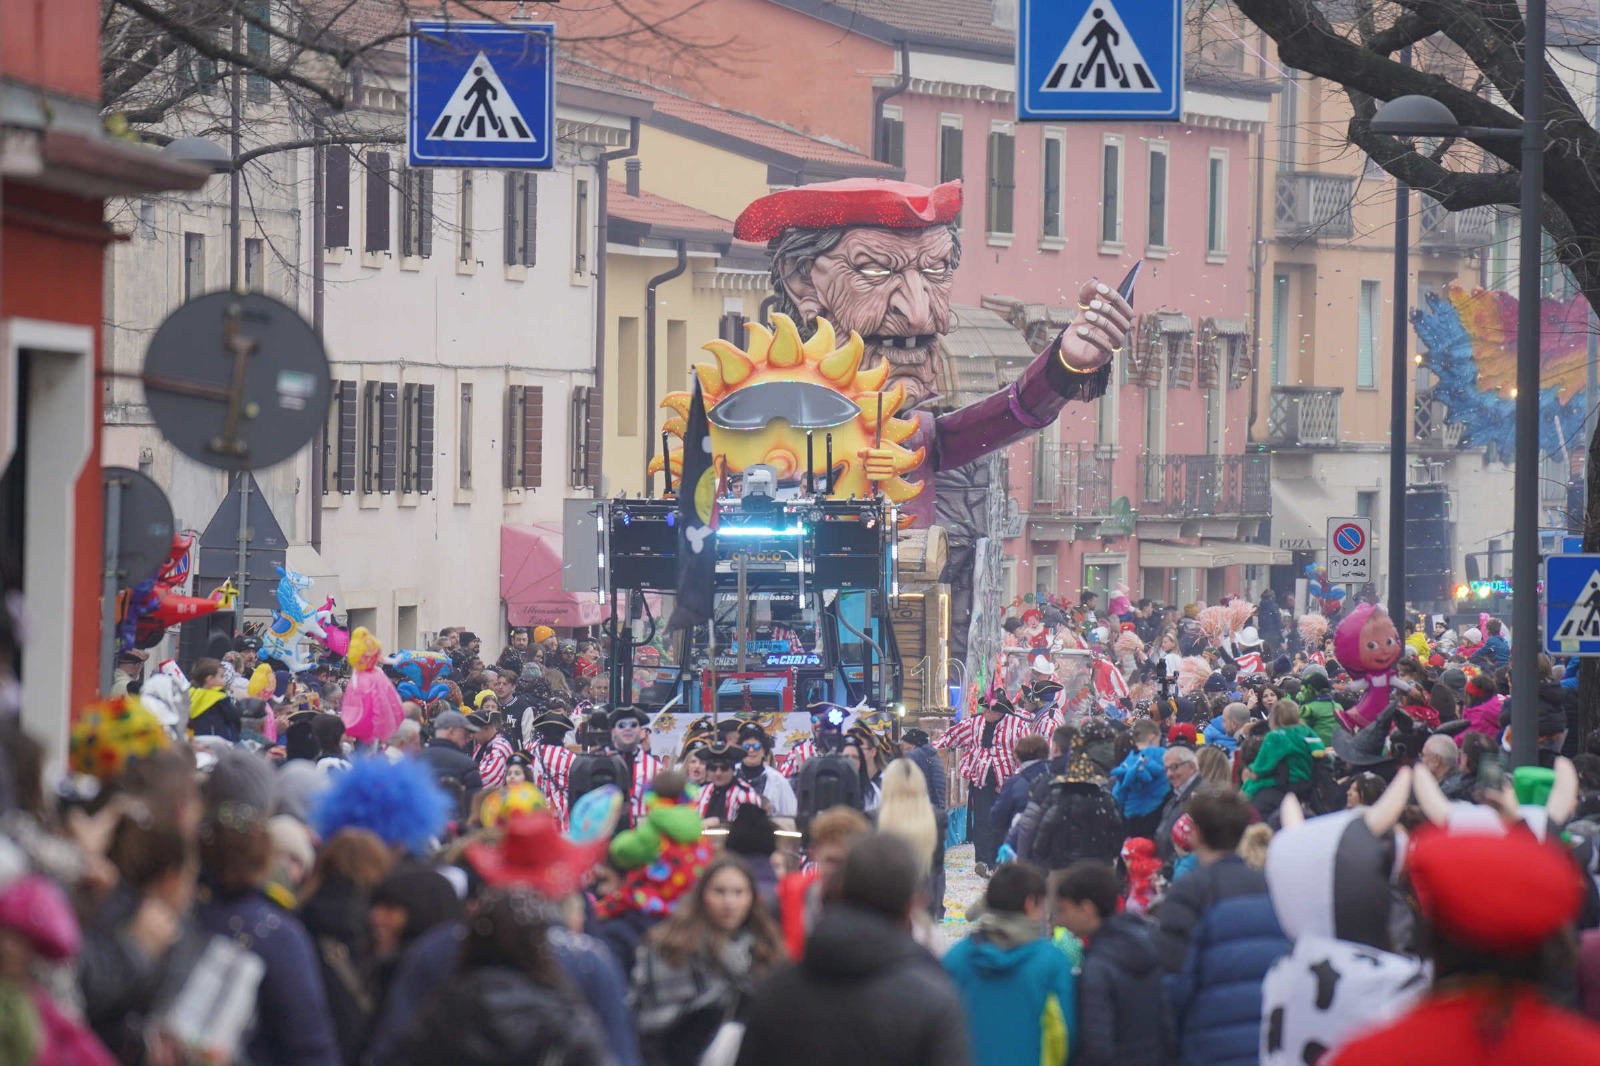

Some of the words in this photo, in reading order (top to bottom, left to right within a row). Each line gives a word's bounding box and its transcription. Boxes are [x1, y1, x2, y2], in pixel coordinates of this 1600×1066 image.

[1280, 538, 1312, 549] PIZZA
[779, 655, 807, 665] CHRI
[506, 714, 517, 728] NY
